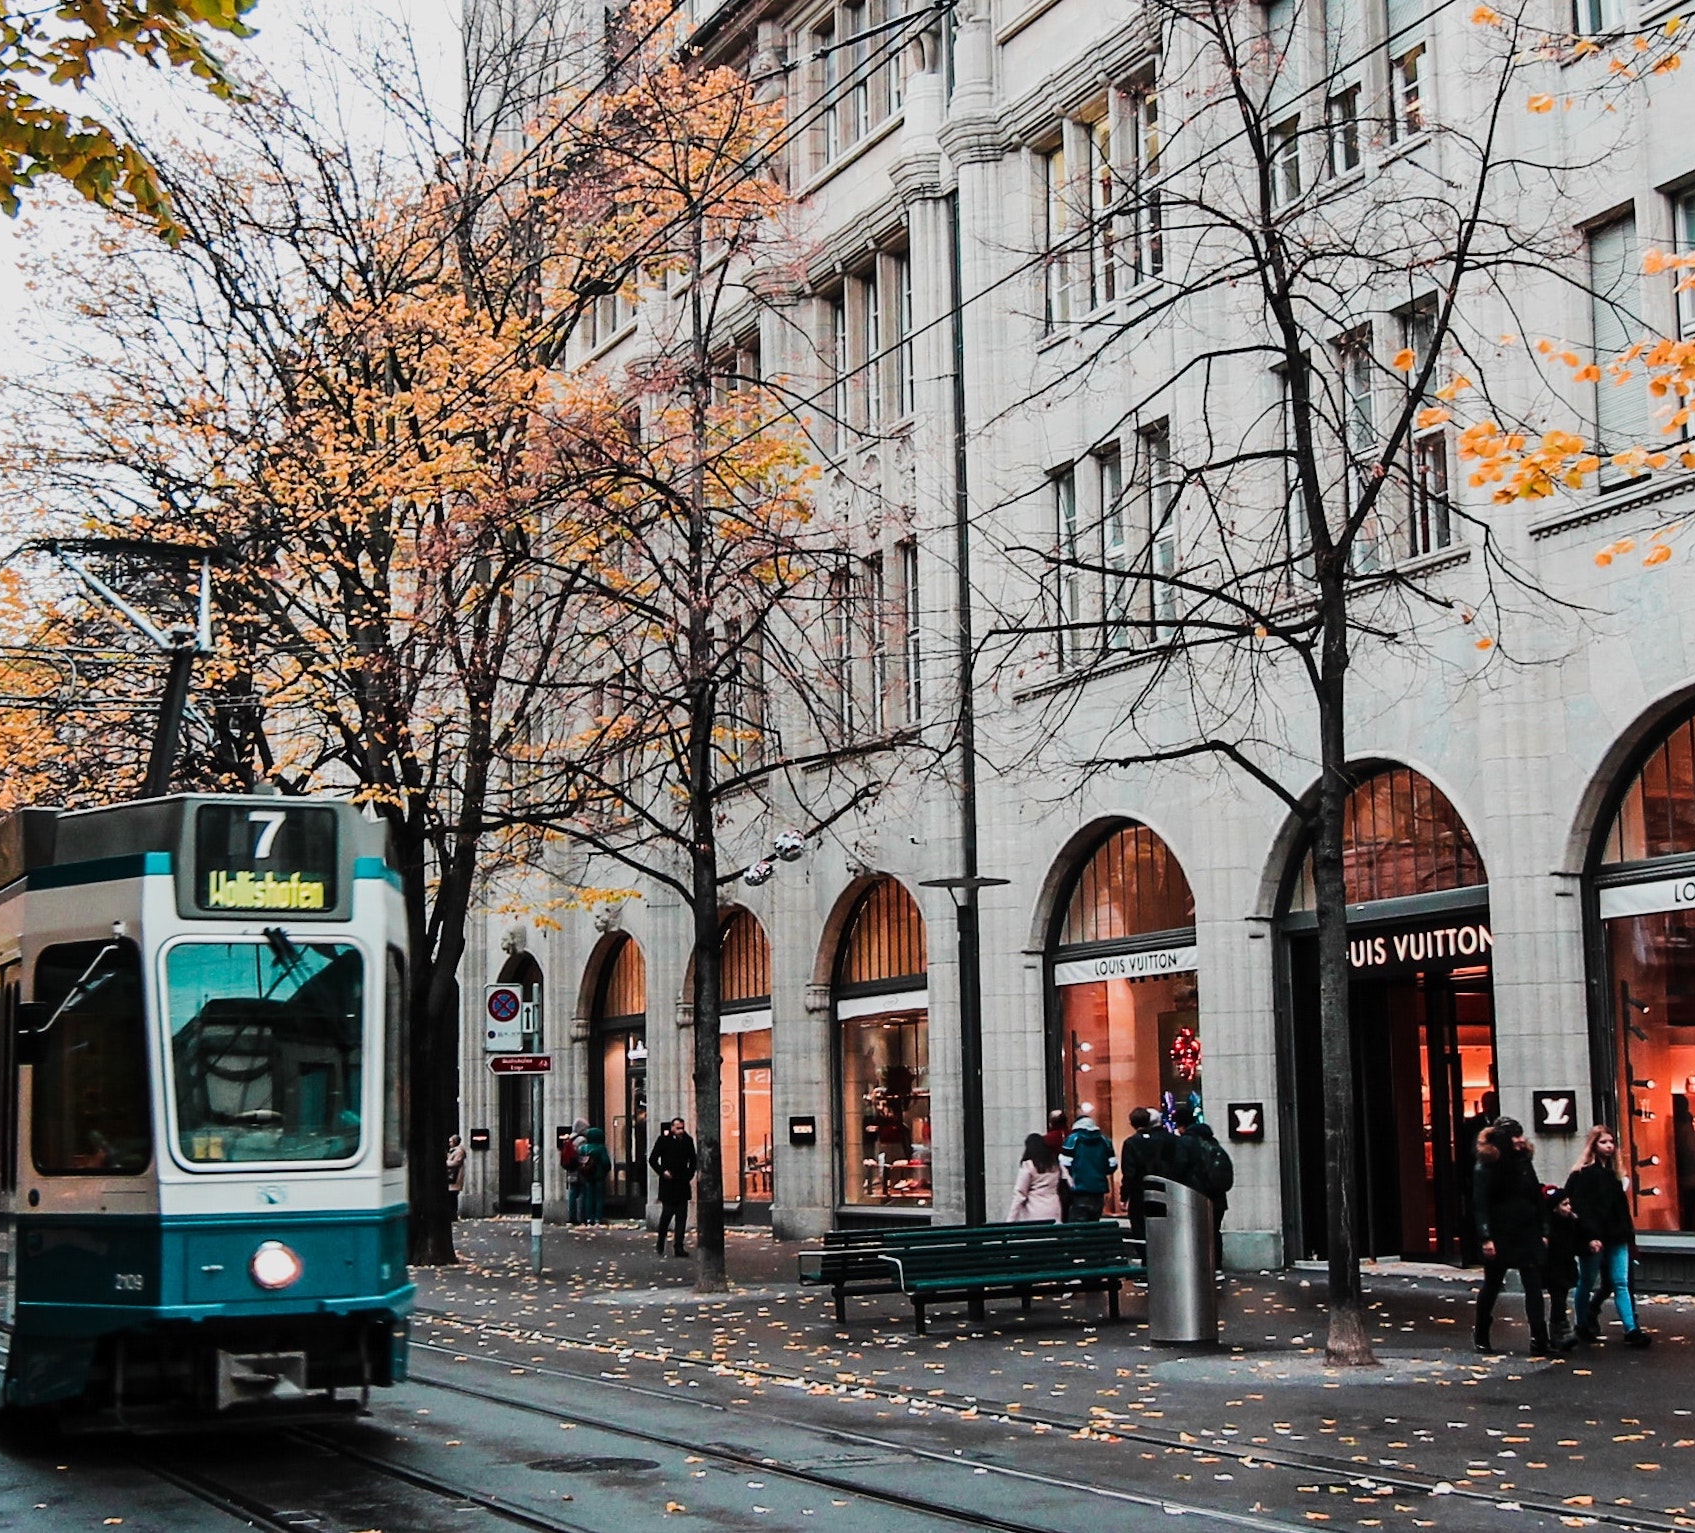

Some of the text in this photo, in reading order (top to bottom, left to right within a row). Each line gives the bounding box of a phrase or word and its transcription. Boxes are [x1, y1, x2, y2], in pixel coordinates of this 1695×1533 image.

[248, 811, 287, 859] 7
[209, 870, 324, 908] Wollishofen
[1095, 953, 1177, 976] LOUIS VUITTON
[1346, 925, 1494, 968] UIS VUITTON
